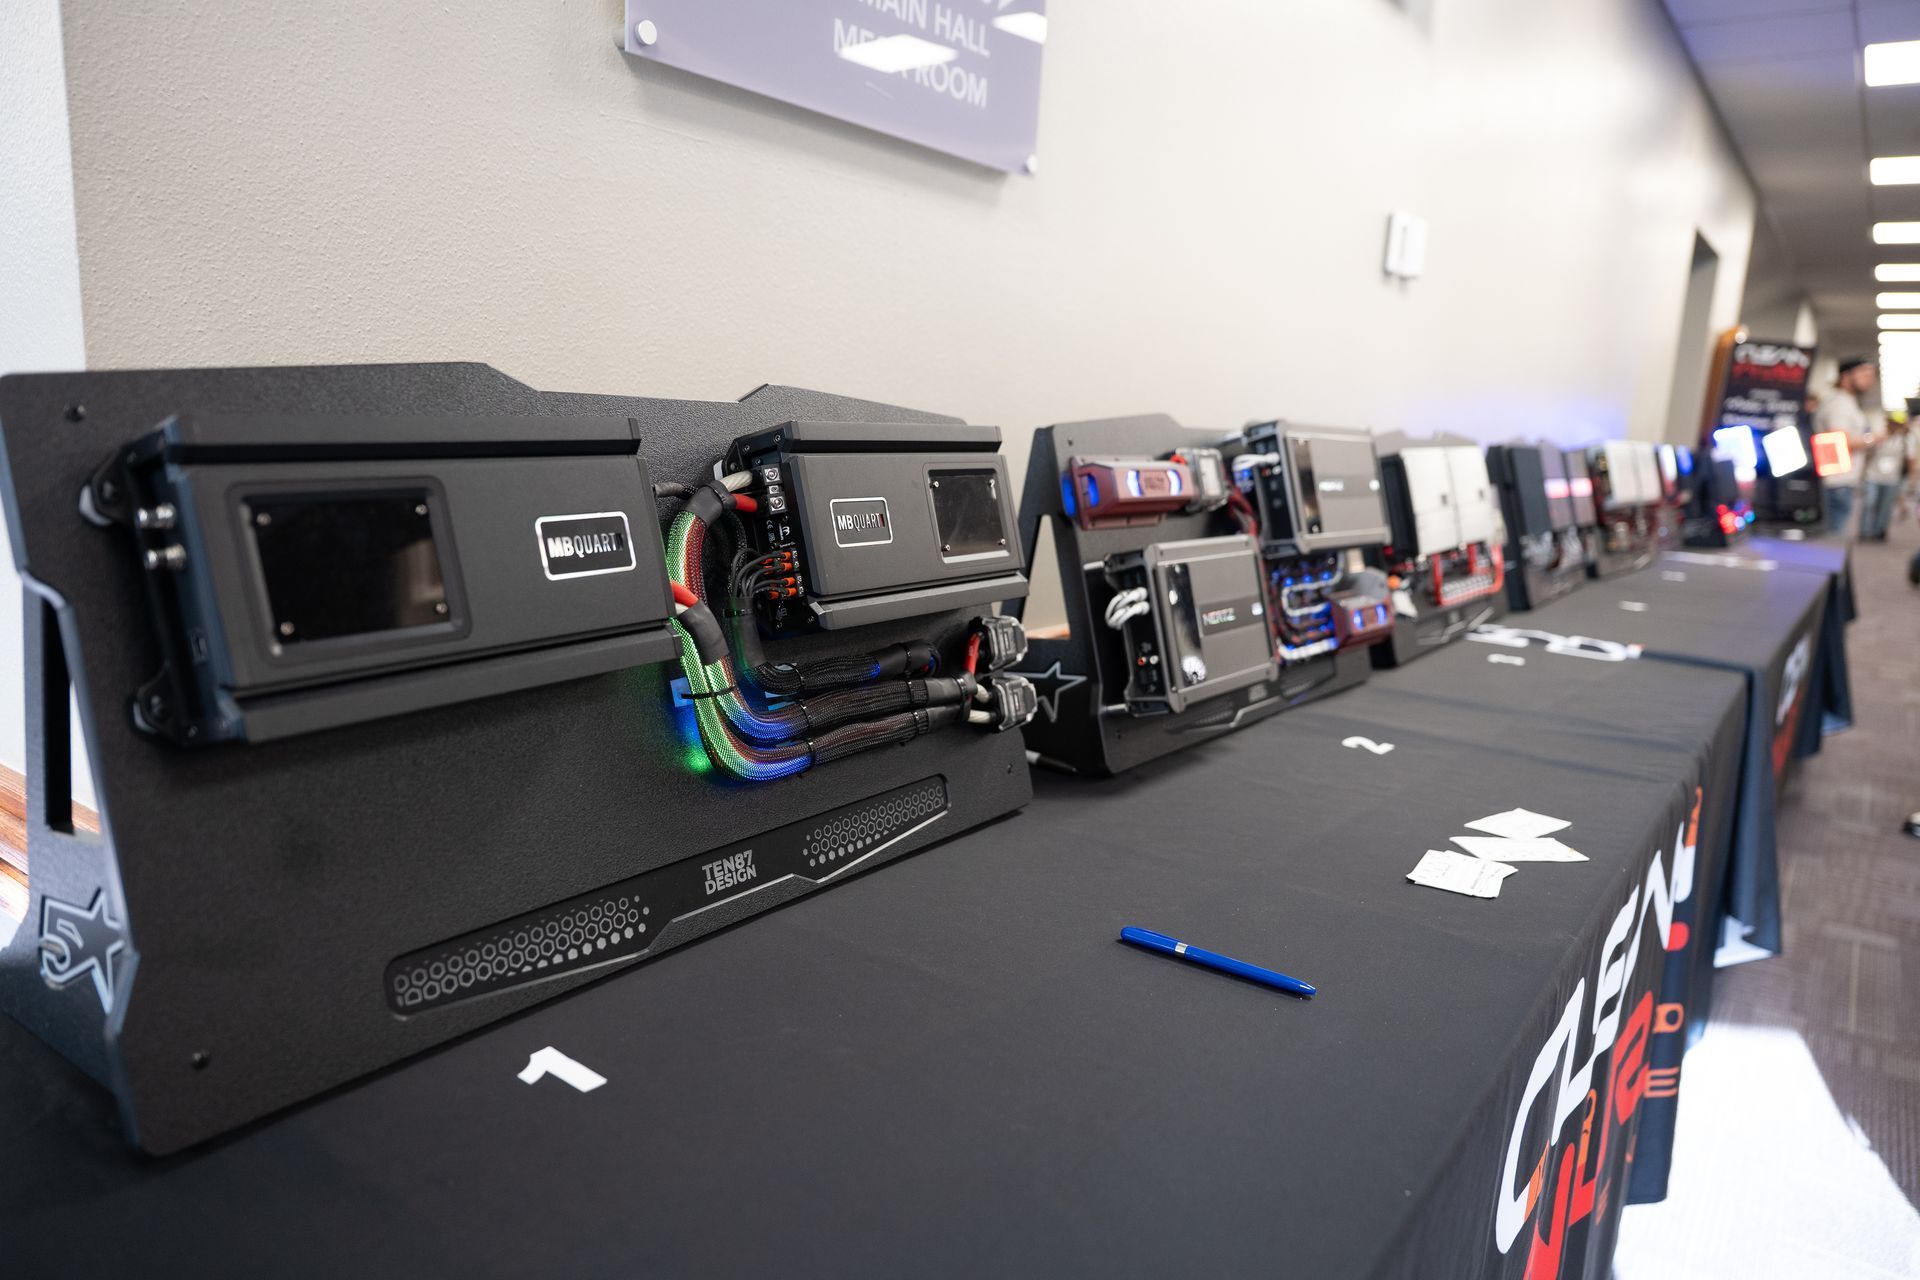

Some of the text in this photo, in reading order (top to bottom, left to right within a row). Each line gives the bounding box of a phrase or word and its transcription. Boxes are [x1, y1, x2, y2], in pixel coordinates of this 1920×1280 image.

[858, 0, 928, 29] AIN
[934, 3, 991, 58] HALL
[701, 849, 753, 881] TEN87
[704, 864, 757, 895] DESIGN
[516, 1045, 609, 1093] 1
